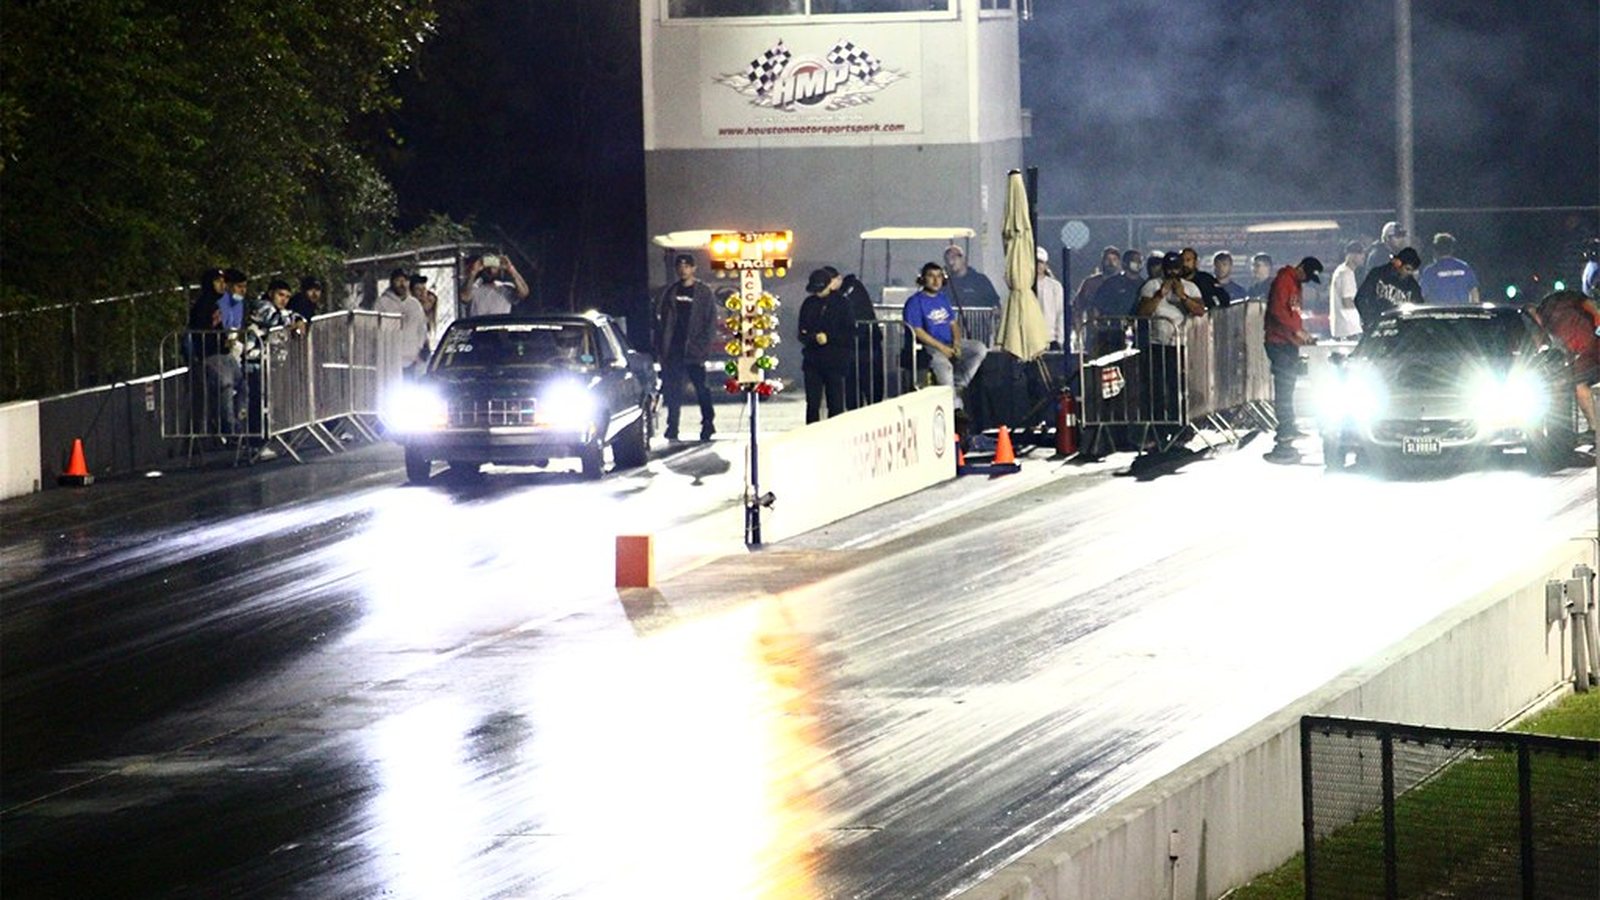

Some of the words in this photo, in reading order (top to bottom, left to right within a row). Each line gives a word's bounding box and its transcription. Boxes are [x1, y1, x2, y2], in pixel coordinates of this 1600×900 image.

[772, 62, 850, 107] HMP
[718, 123, 905, 136] www.houstonmotorsportspark.com
[724, 260, 774, 270] STAGE
